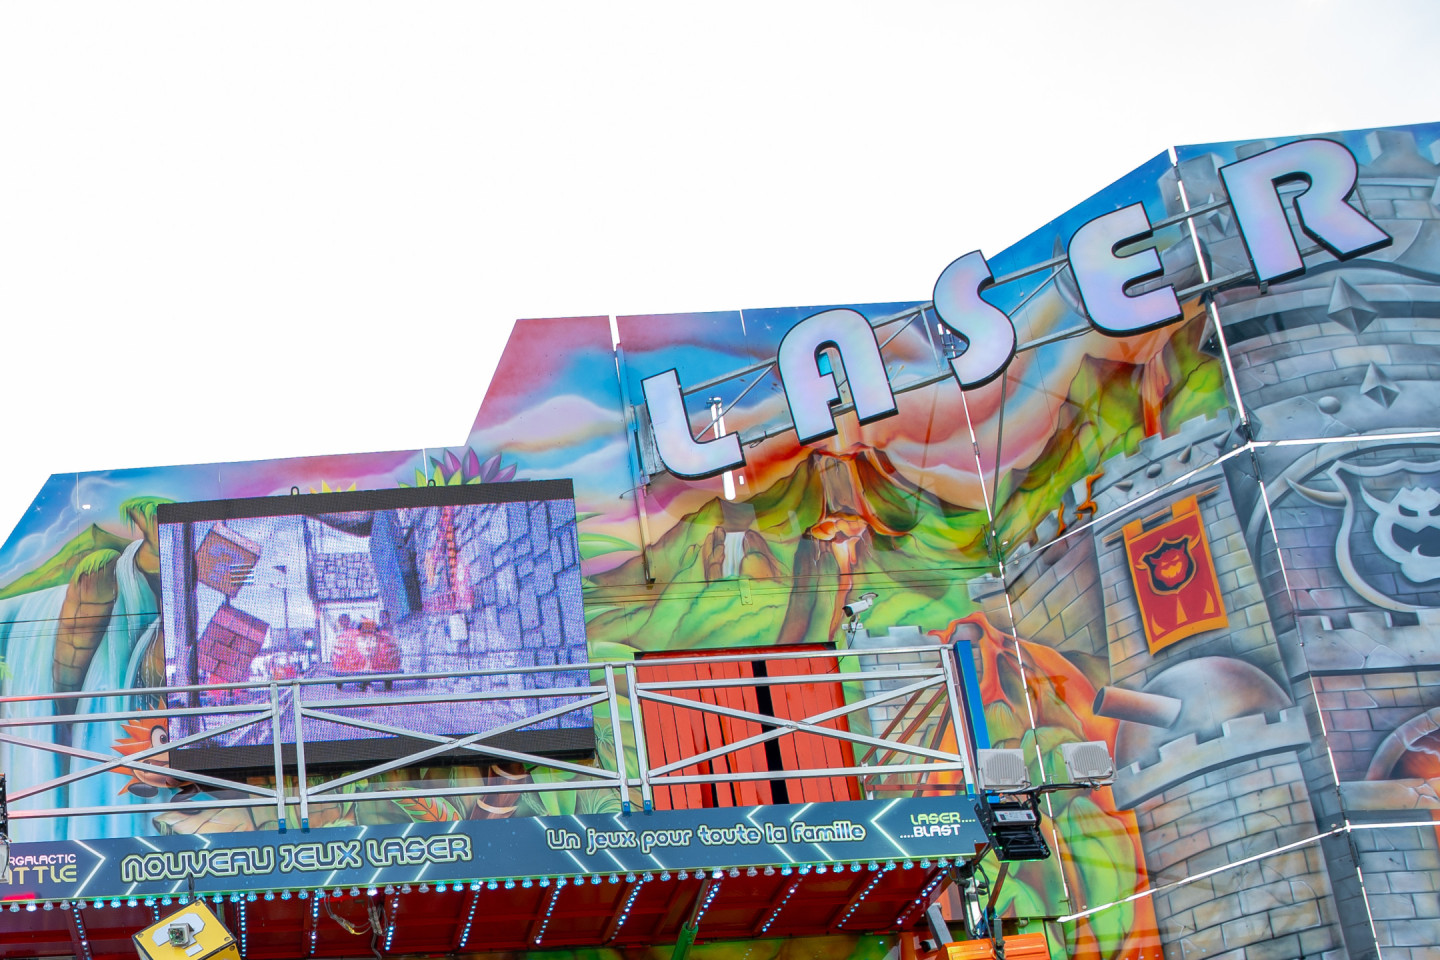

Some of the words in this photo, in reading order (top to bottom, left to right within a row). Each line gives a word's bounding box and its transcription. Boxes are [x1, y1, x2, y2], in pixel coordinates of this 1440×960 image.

[640, 137, 1393, 481] LASER
[122, 846, 275, 882] NOUVEAU
[280, 840, 362, 873] JEUX
[366, 834, 472, 868] LASER
[546, 829, 581, 849] Un
[586, 828, 636, 855] jeux
[640, 829, 692, 854] pour
[697, 824, 761, 845] toute
[764, 822, 787, 844] la
[791, 821, 866, 843] famille
[9, 854, 76, 866] RGALACTIC
